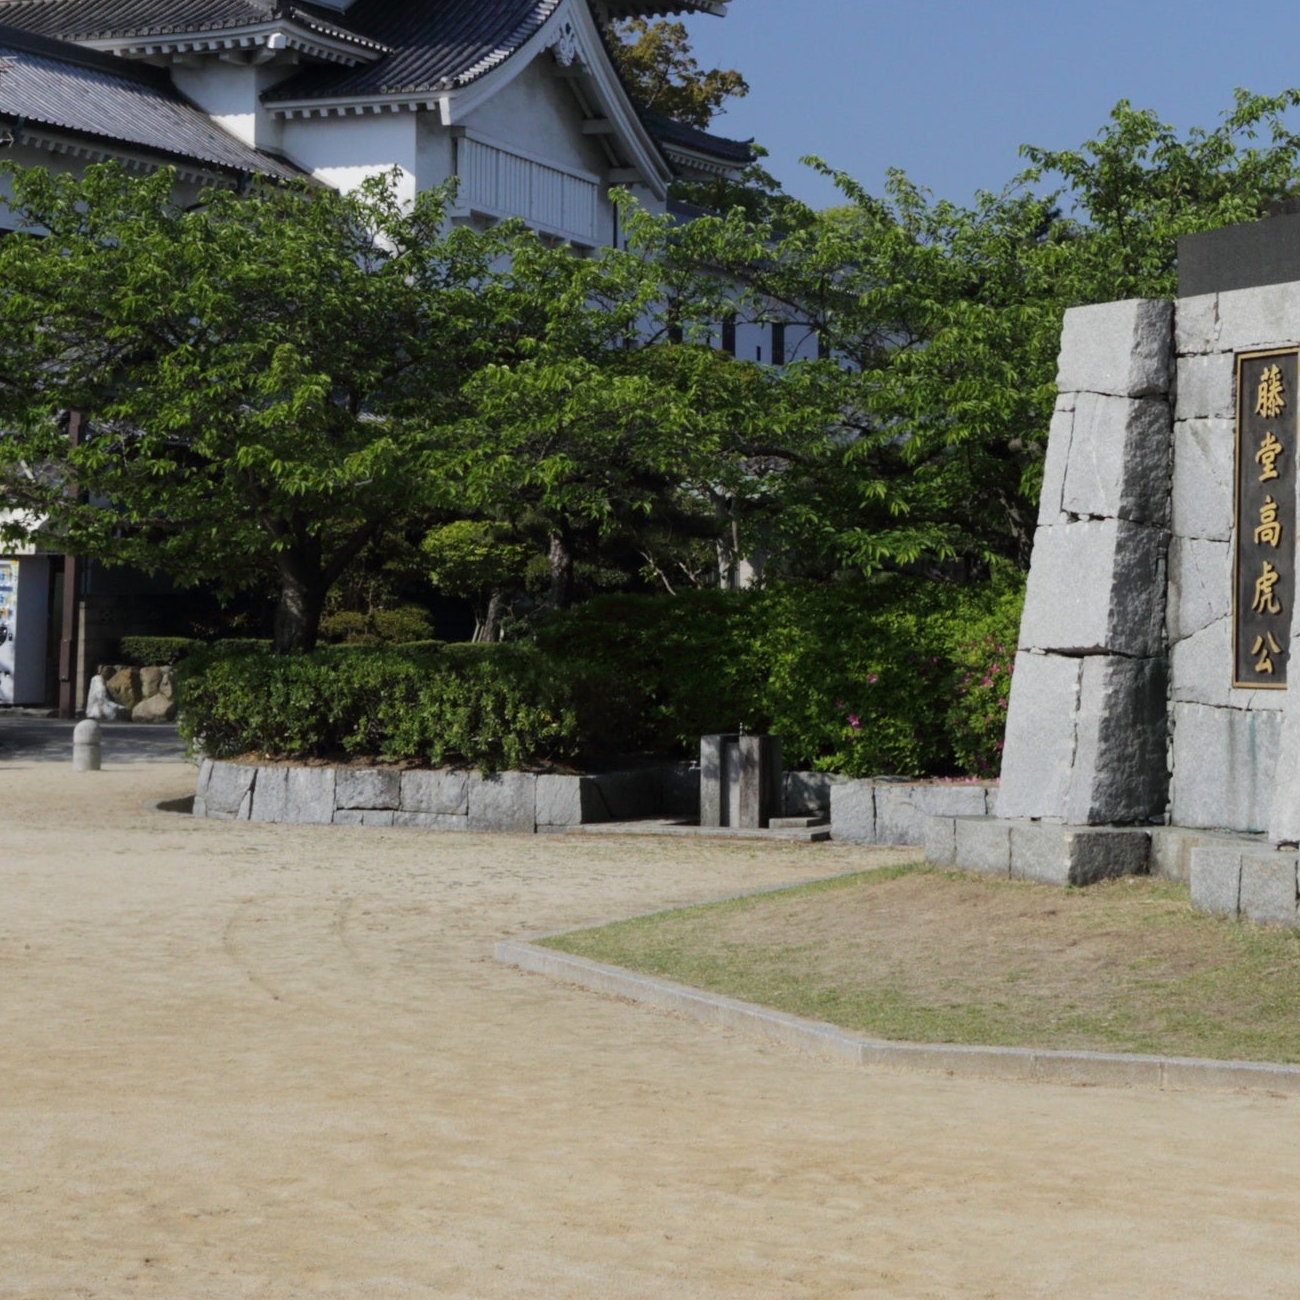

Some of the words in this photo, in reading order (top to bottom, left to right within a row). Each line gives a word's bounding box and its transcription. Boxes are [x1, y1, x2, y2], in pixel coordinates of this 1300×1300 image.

[1251, 363, 1285, 674] 藤堂高虎公
